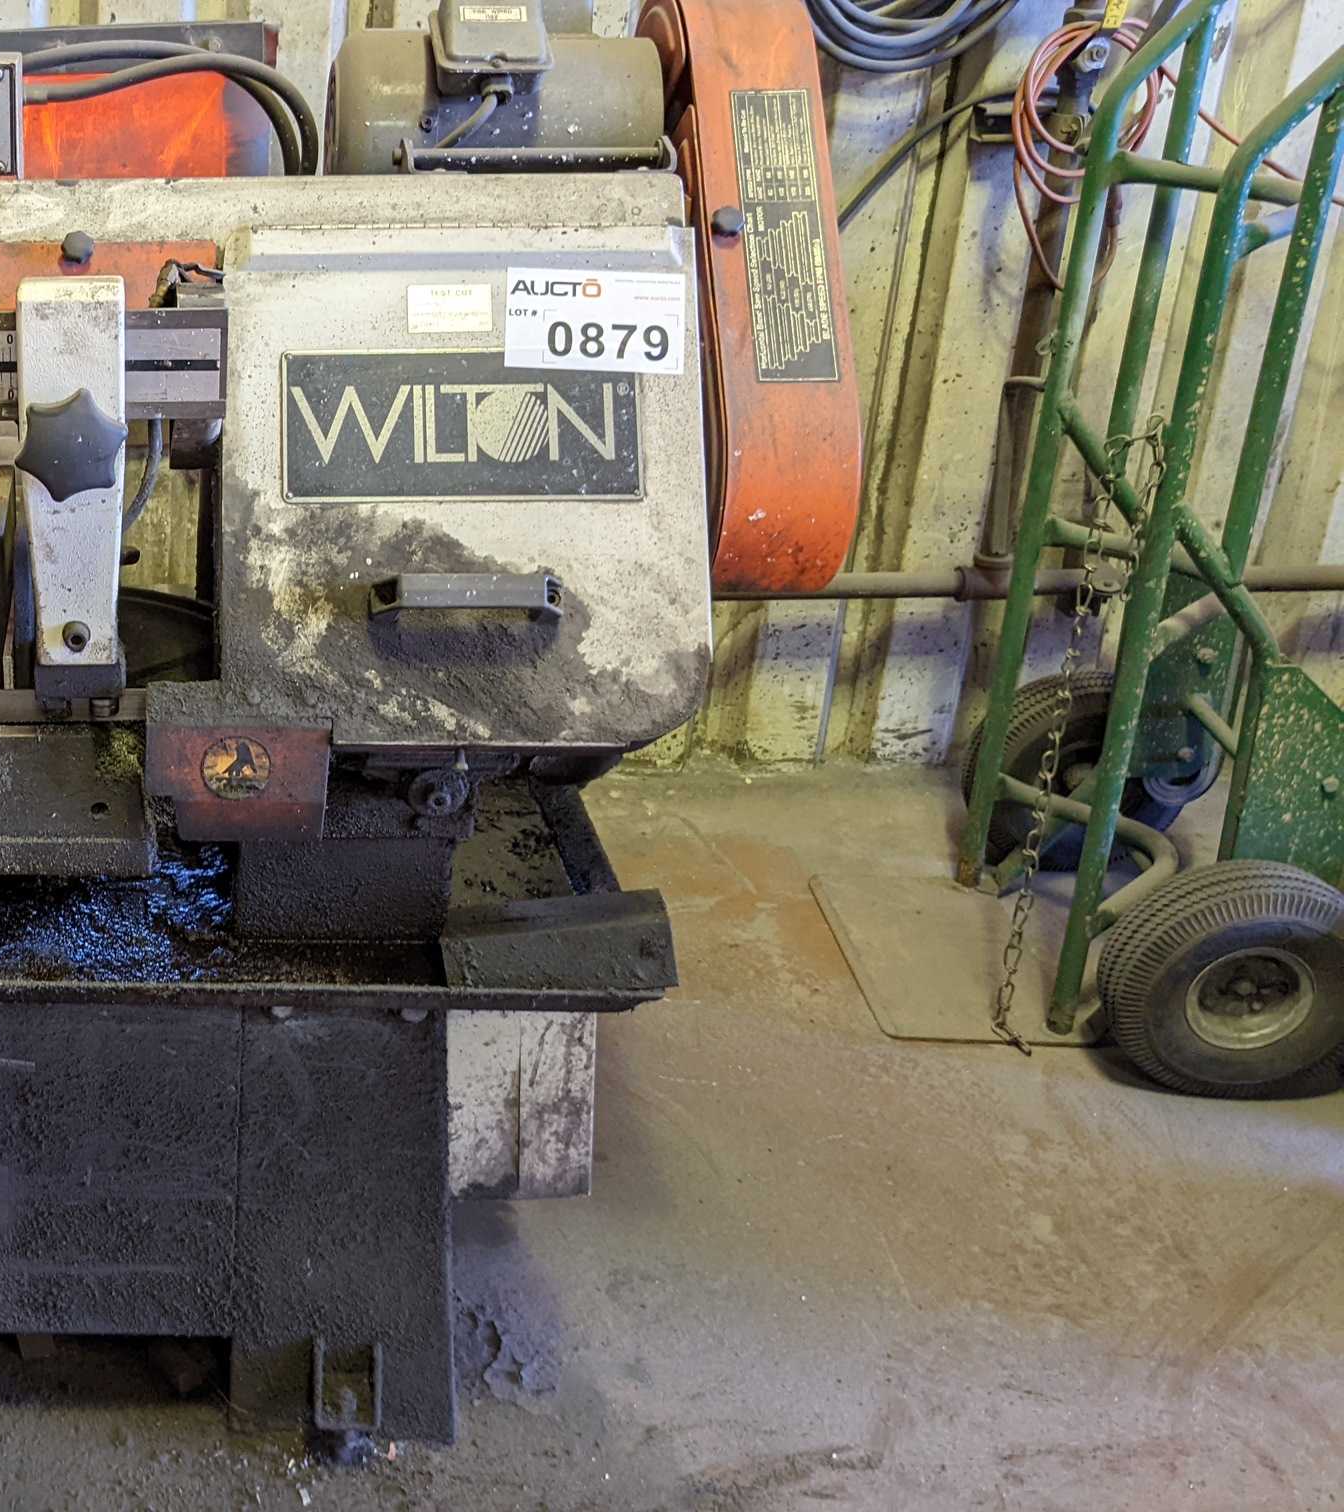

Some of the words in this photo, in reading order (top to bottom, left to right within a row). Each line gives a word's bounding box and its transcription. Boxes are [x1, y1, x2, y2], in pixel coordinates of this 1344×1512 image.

[745, 212, 754, 233] Chart
[755, 205, 765, 232] MOTOR
[747, 234, 758, 267] Selection
[750, 268, 761, 292] Speed
[509, 308, 529, 317] LOT
[531, 308, 538, 317] #
[819, 312, 831, 340] BLADE
[7, 335, 14, 346] 0
[547, 321, 670, 362] 0879
[8, 389, 14, 400] 0
[290, 384, 616, 465] WILTON
